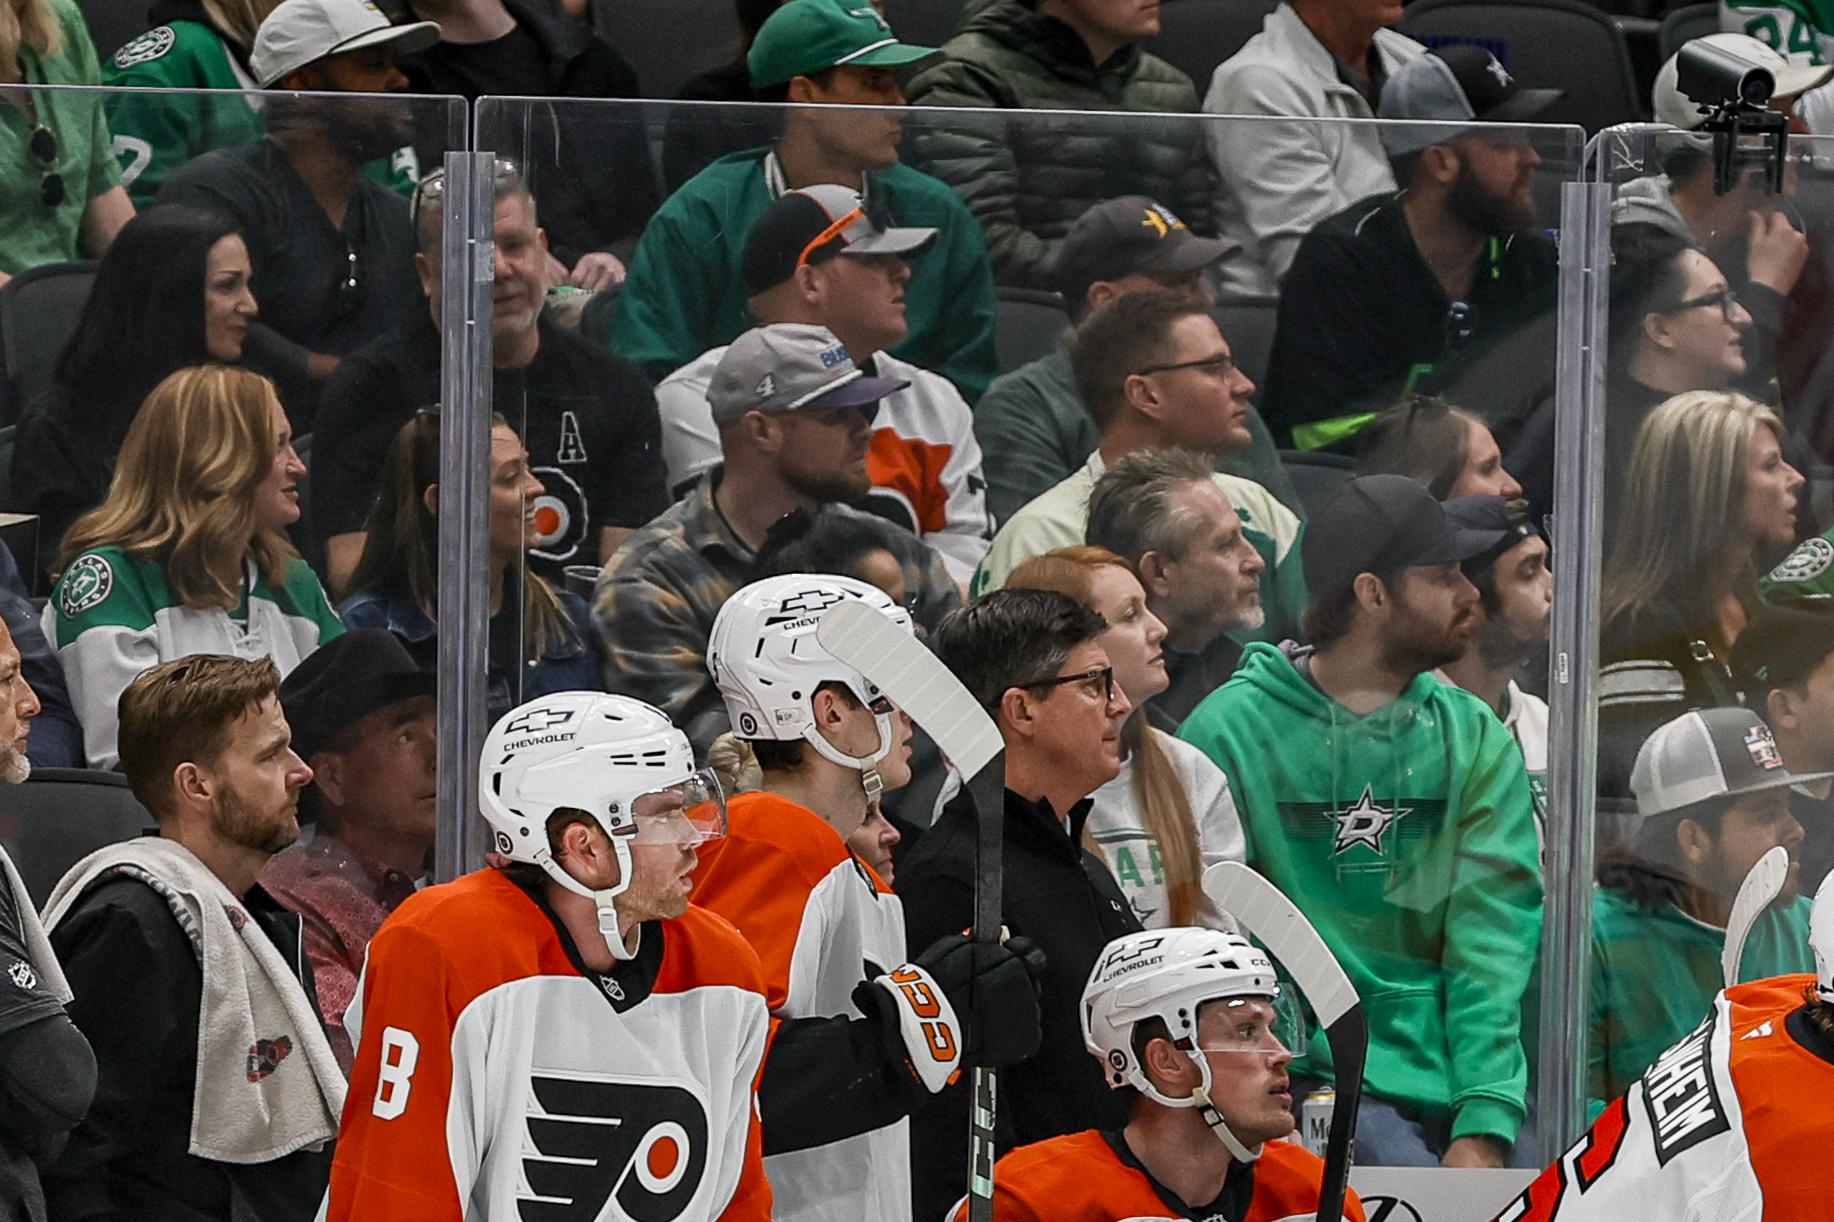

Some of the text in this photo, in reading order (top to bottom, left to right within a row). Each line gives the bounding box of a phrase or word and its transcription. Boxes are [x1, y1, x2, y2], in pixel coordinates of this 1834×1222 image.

[755, 372, 776, 398] 4
[558, 411, 587, 463] A
[503, 732, 576, 752] CHEVROLET
[1103, 955, 1165, 983] CHEVROLET
[372, 1026, 420, 1120] 8
